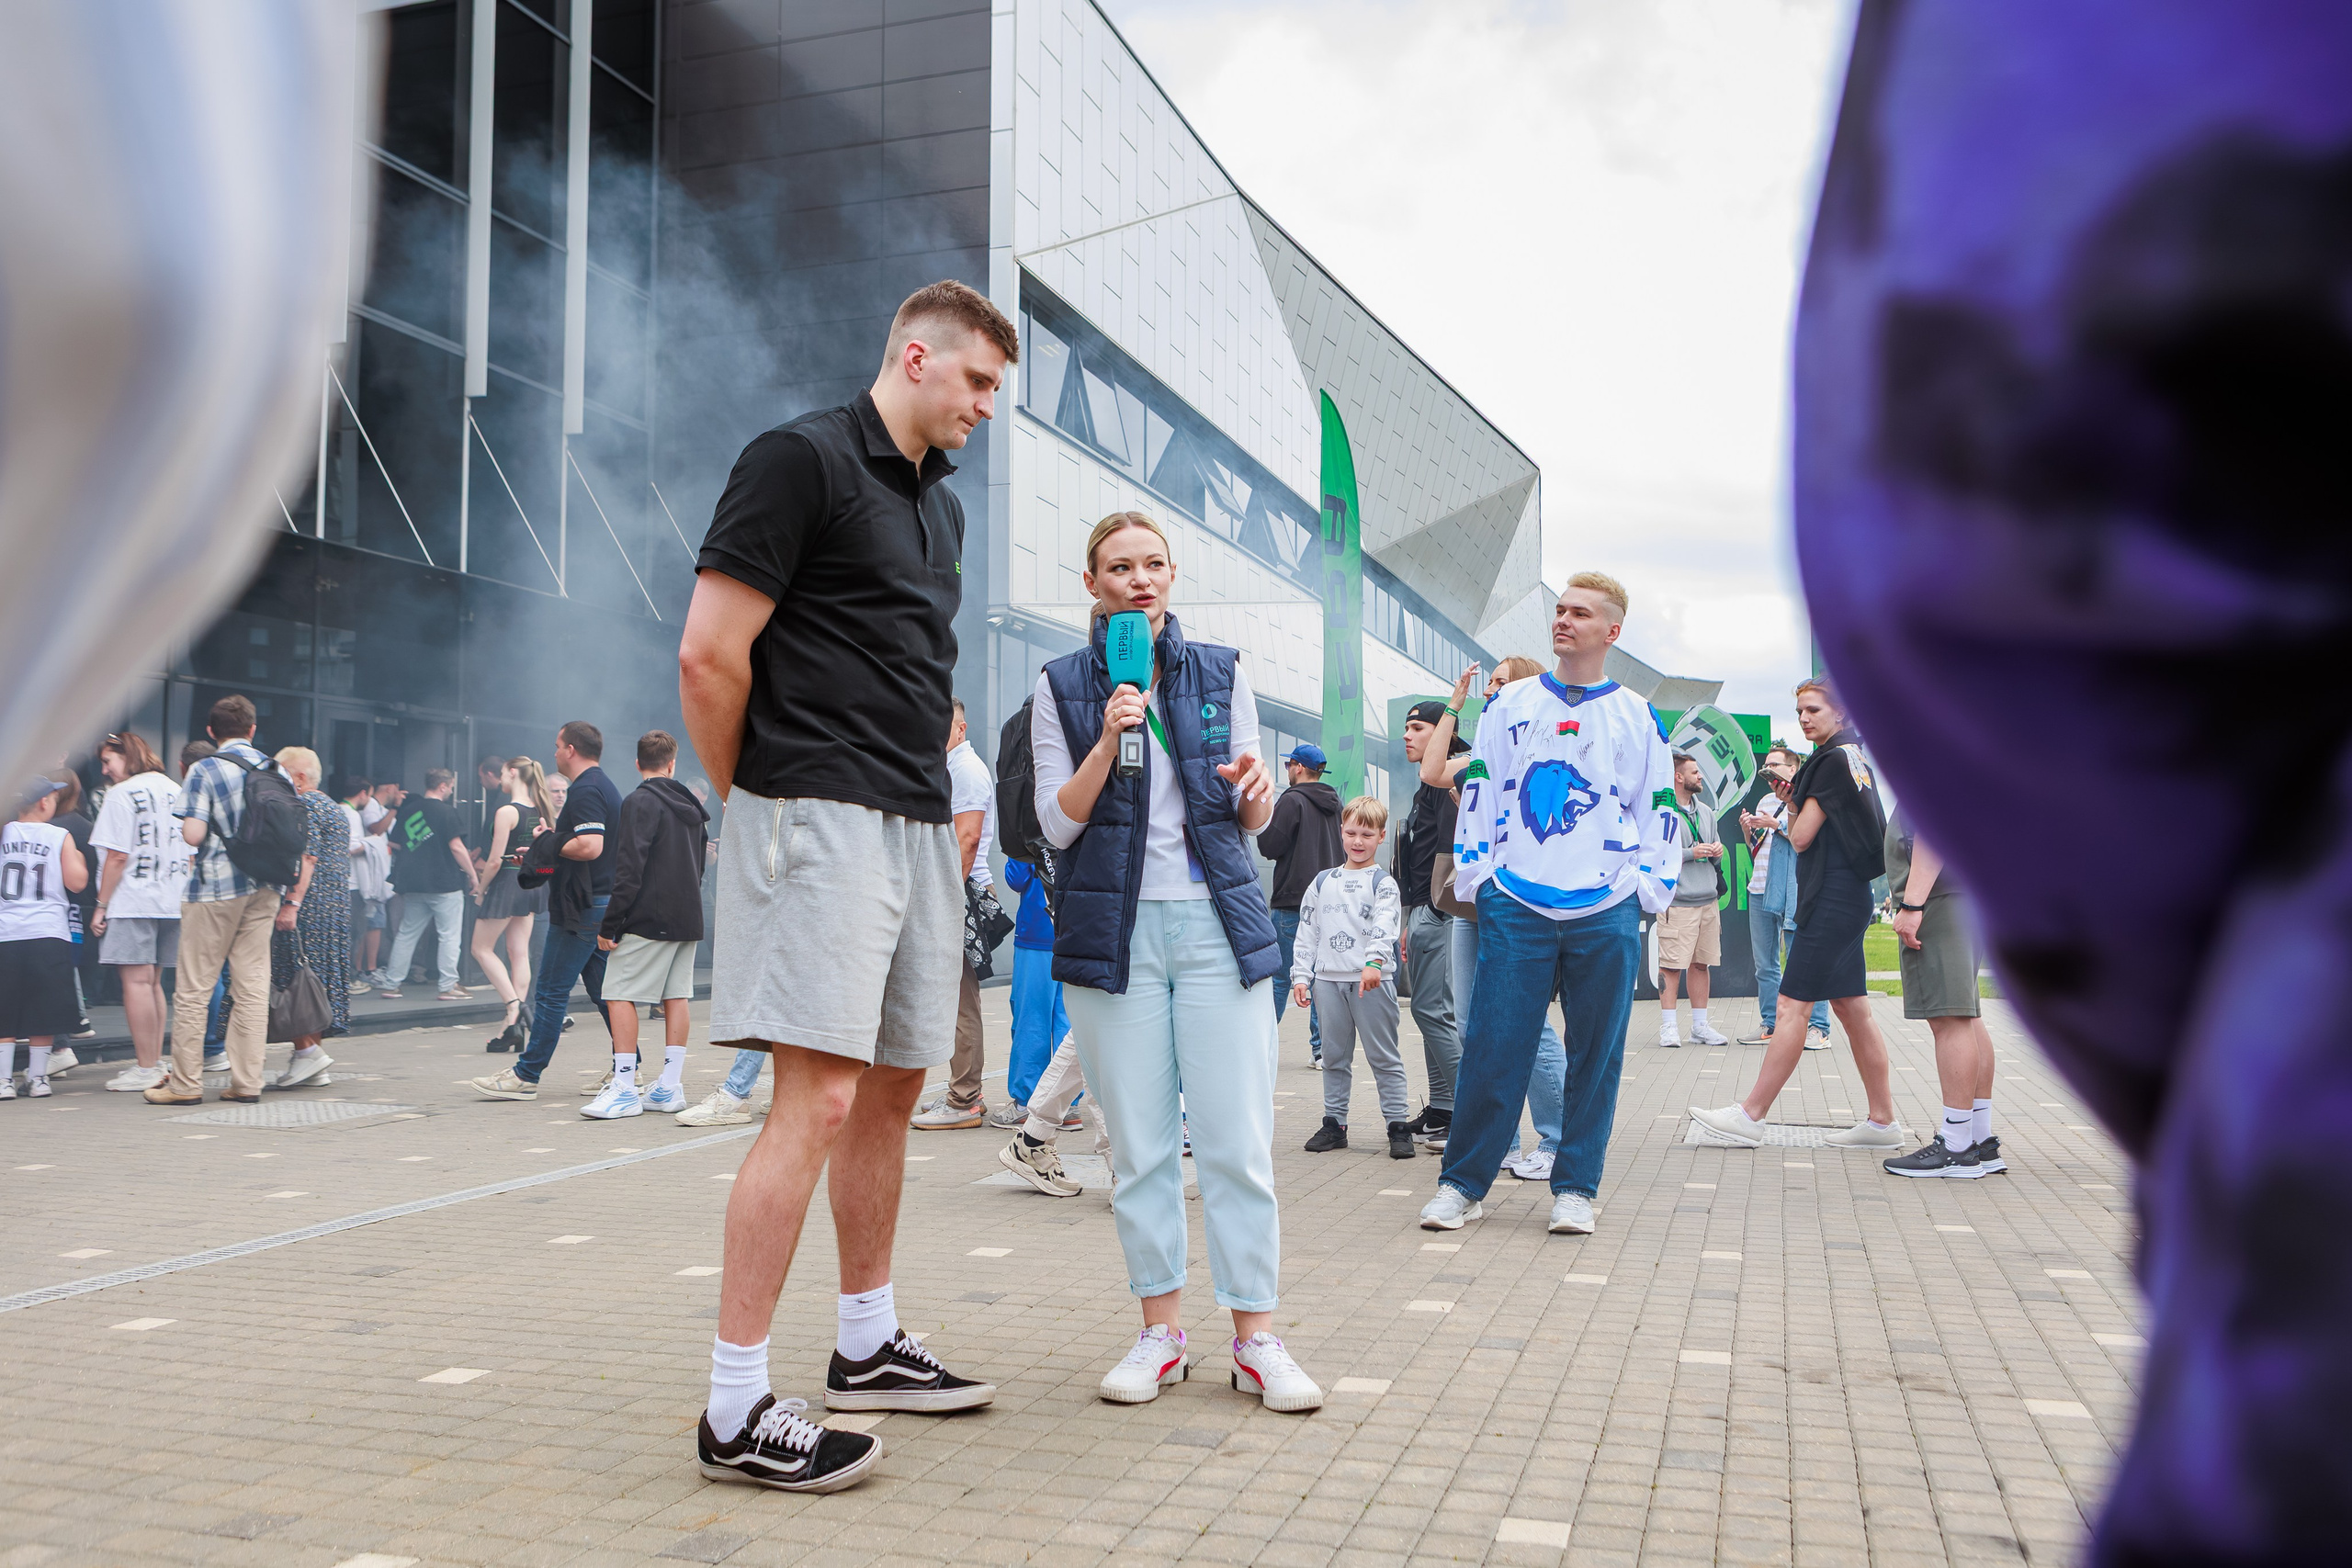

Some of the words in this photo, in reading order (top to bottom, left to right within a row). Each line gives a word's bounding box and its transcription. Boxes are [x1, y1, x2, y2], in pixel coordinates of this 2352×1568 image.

[1118, 621, 1129, 660] ПЕРВЫЙ
[1201, 724, 1230, 738] ПЕРВЫЙ
[1508, 720, 1531, 746] 17
[3, 840, 51, 857] UNIFIED
[0, 861, 48, 902] 01
